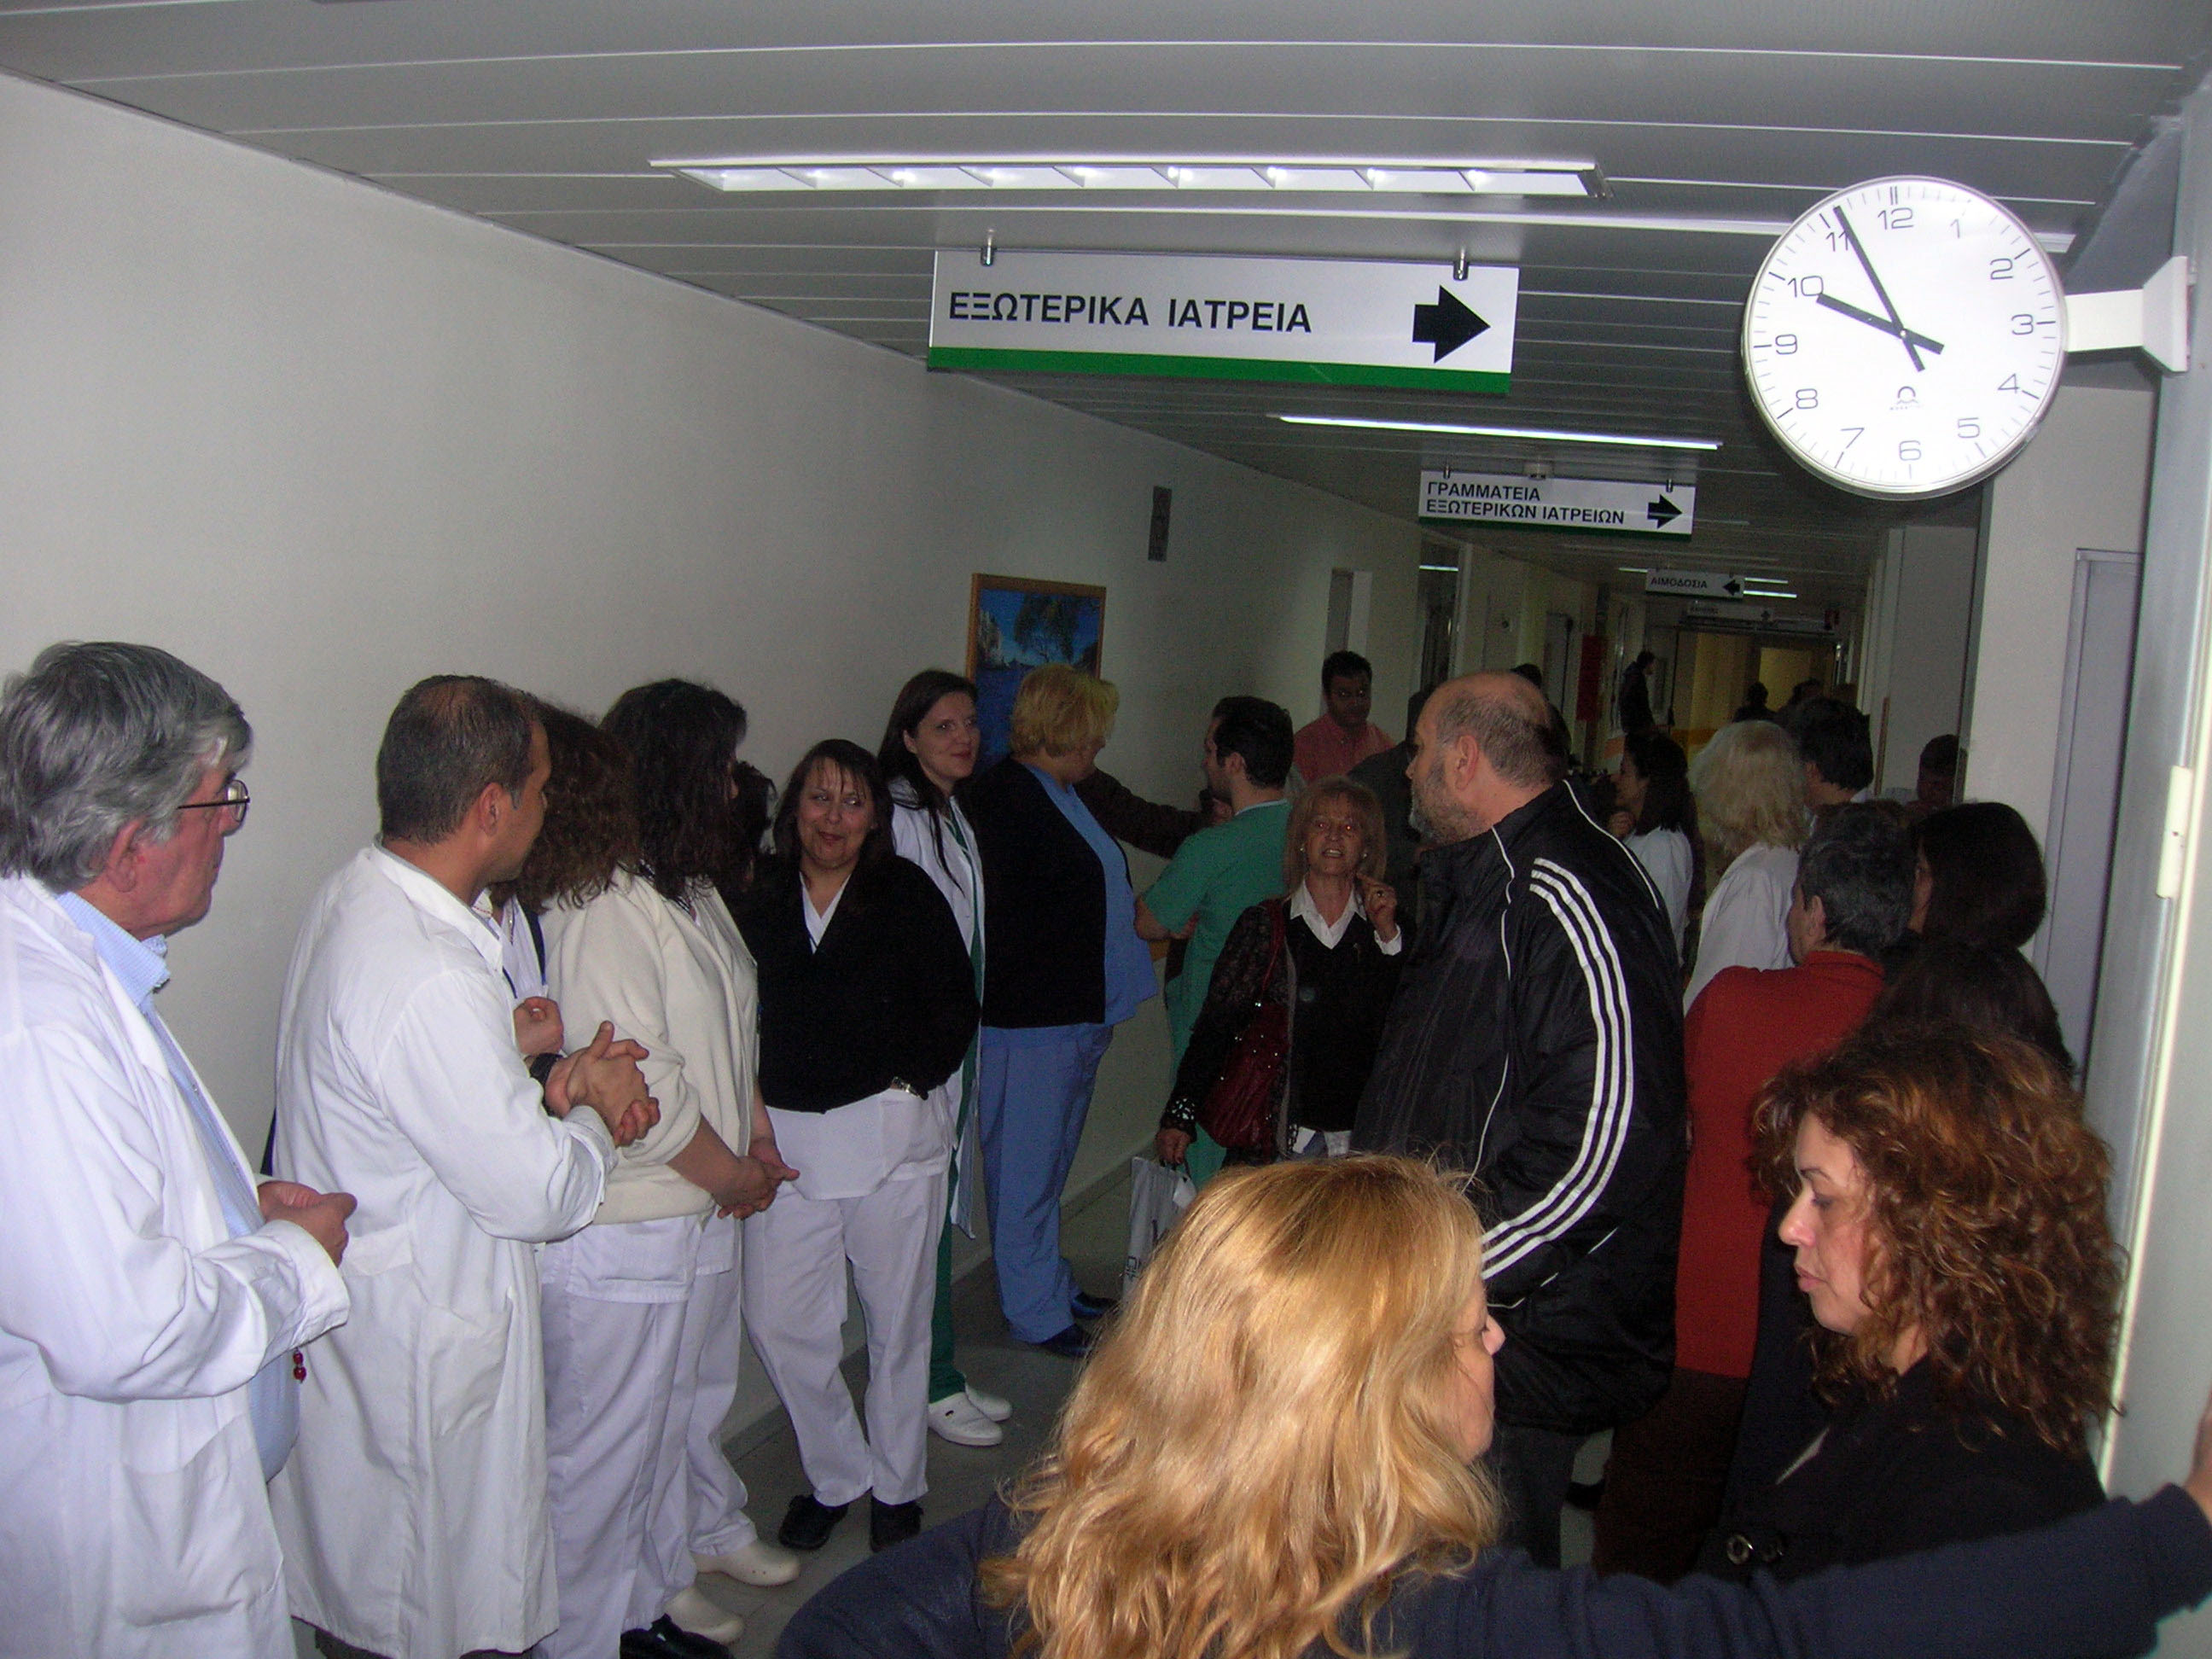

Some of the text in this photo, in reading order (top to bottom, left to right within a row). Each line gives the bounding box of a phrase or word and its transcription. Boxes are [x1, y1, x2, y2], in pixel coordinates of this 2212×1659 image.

[1877, 207, 1914, 230] 12
[1950, 218, 1961, 239] 1
[1825, 230, 1849, 253] 11
[1989, 258, 2014, 280] 2
[1787, 275, 1825, 298] 10
[948, 291, 1313, 334] ΕΞΩΤΕΡΙΚΑ ΙΑΤΡΕΙΑ
[2011, 313, 2034, 335] 3
[1775, 334, 1798, 356] 9
[1997, 373, 2021, 395] 4
[1796, 388, 1819, 410] 8
[1840, 427, 1866, 450] 7
[1957, 416, 1981, 439] 5
[1898, 439, 1922, 462] 6
[1426, 480, 1541, 502] ΓΡΑΜΜΑΤΕΙΑ
[1426, 499, 1625, 525] ΕΞΩΤΕΡΙΚΩΝ ΙΑΤΡΕΙΩΝ
[1650, 577, 1708, 589] ΑΙΜΟΔΟΣΙΑ
